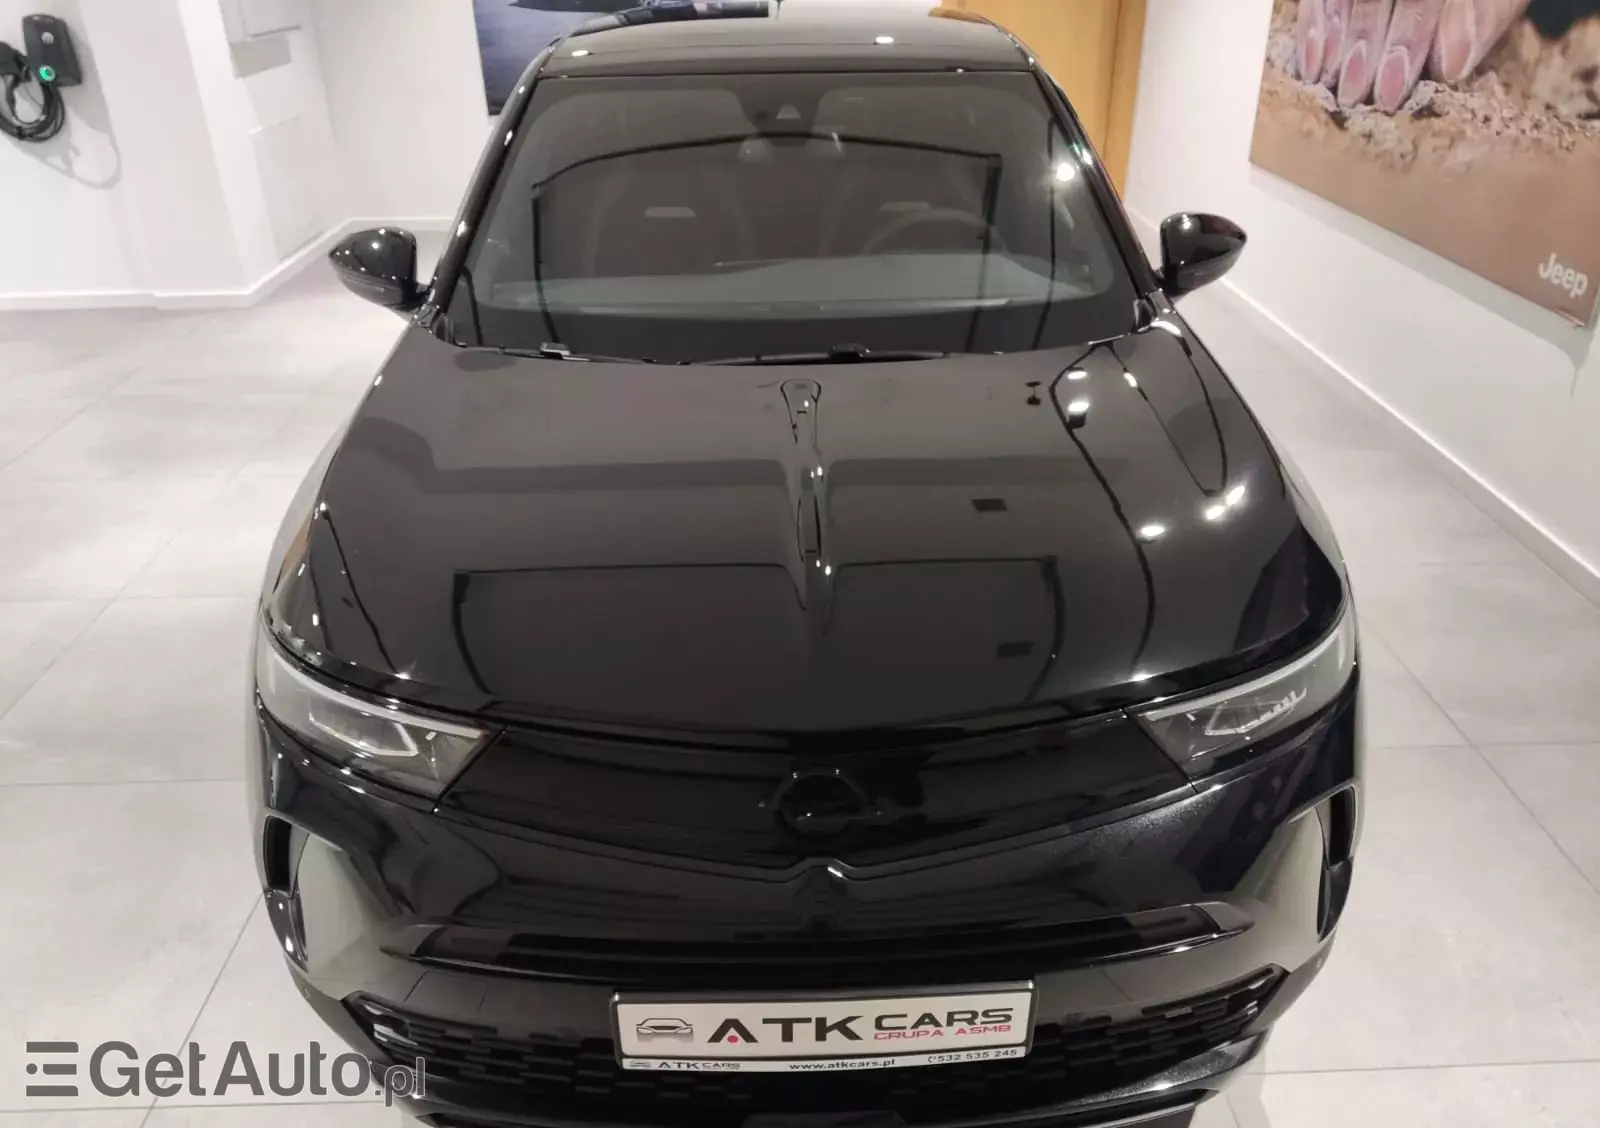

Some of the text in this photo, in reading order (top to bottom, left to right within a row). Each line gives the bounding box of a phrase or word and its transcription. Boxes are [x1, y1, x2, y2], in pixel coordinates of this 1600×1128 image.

[1538, 252, 1588, 298] Jeep
[707, 1008, 1014, 1043] ATK CARS
[873, 1024, 1012, 1040] GRUPA ASMB
[938, 1054, 961, 1062] 532
[994, 1048, 1017, 1057] 245
[658, 1061, 740, 1070] ATK CARS
[789, 1058, 895, 1070] www.atkcars.pl
